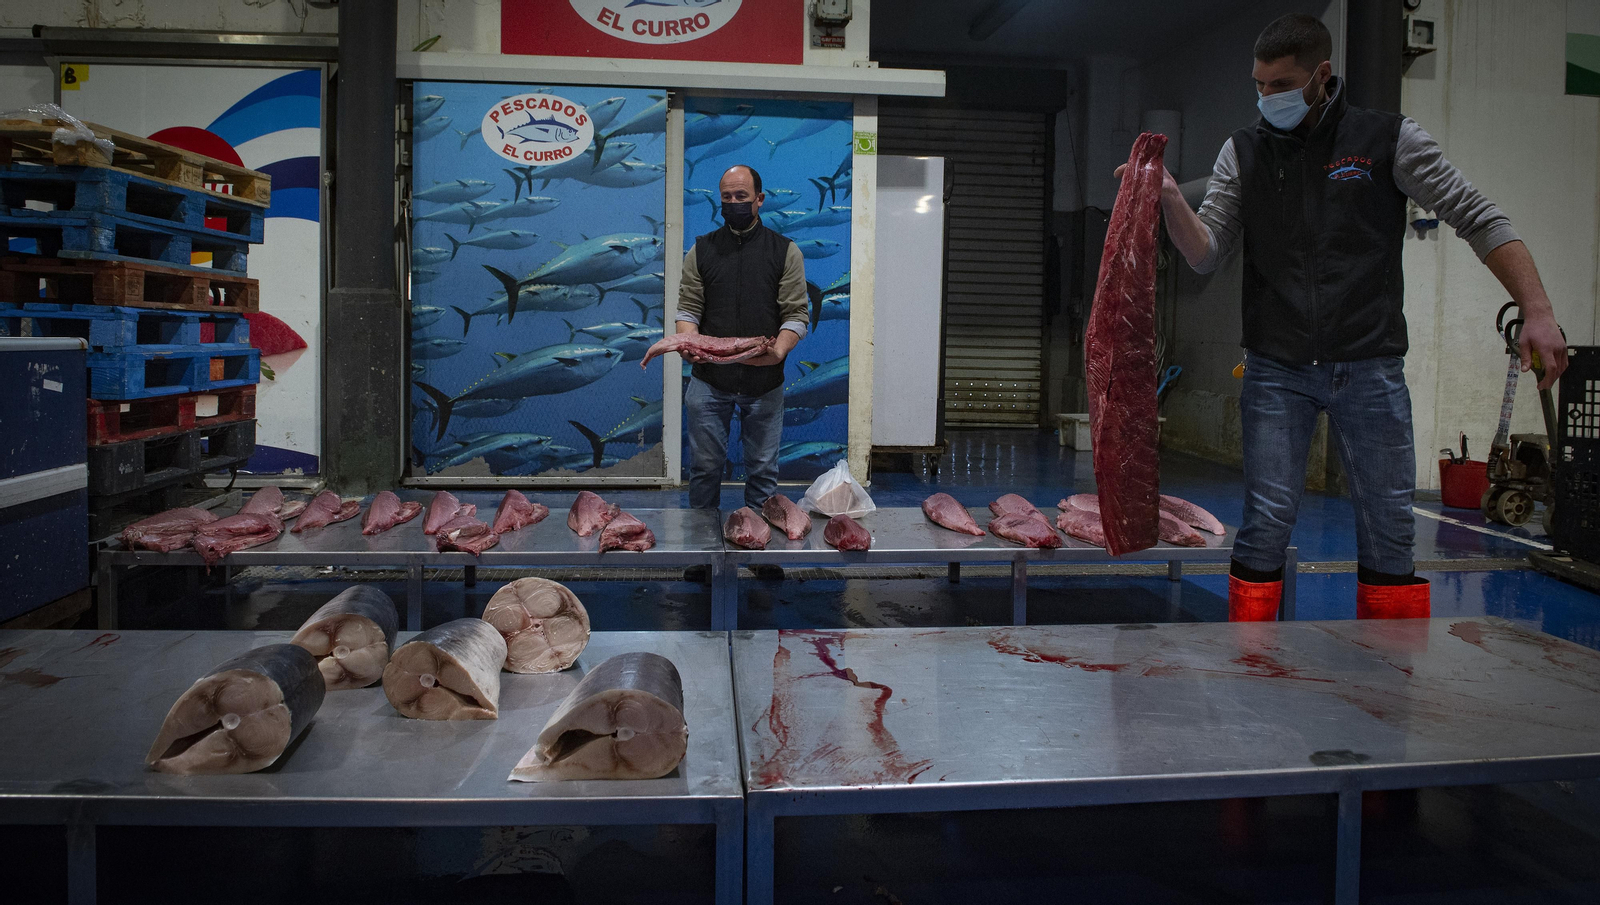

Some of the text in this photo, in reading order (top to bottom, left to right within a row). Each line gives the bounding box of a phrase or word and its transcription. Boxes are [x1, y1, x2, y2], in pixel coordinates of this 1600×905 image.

[597, 7, 710, 37] EL CURRO
[65, 67, 77, 84] B
[489, 98, 588, 127] PESCADOS
[502, 144, 573, 161] EL CURRO
